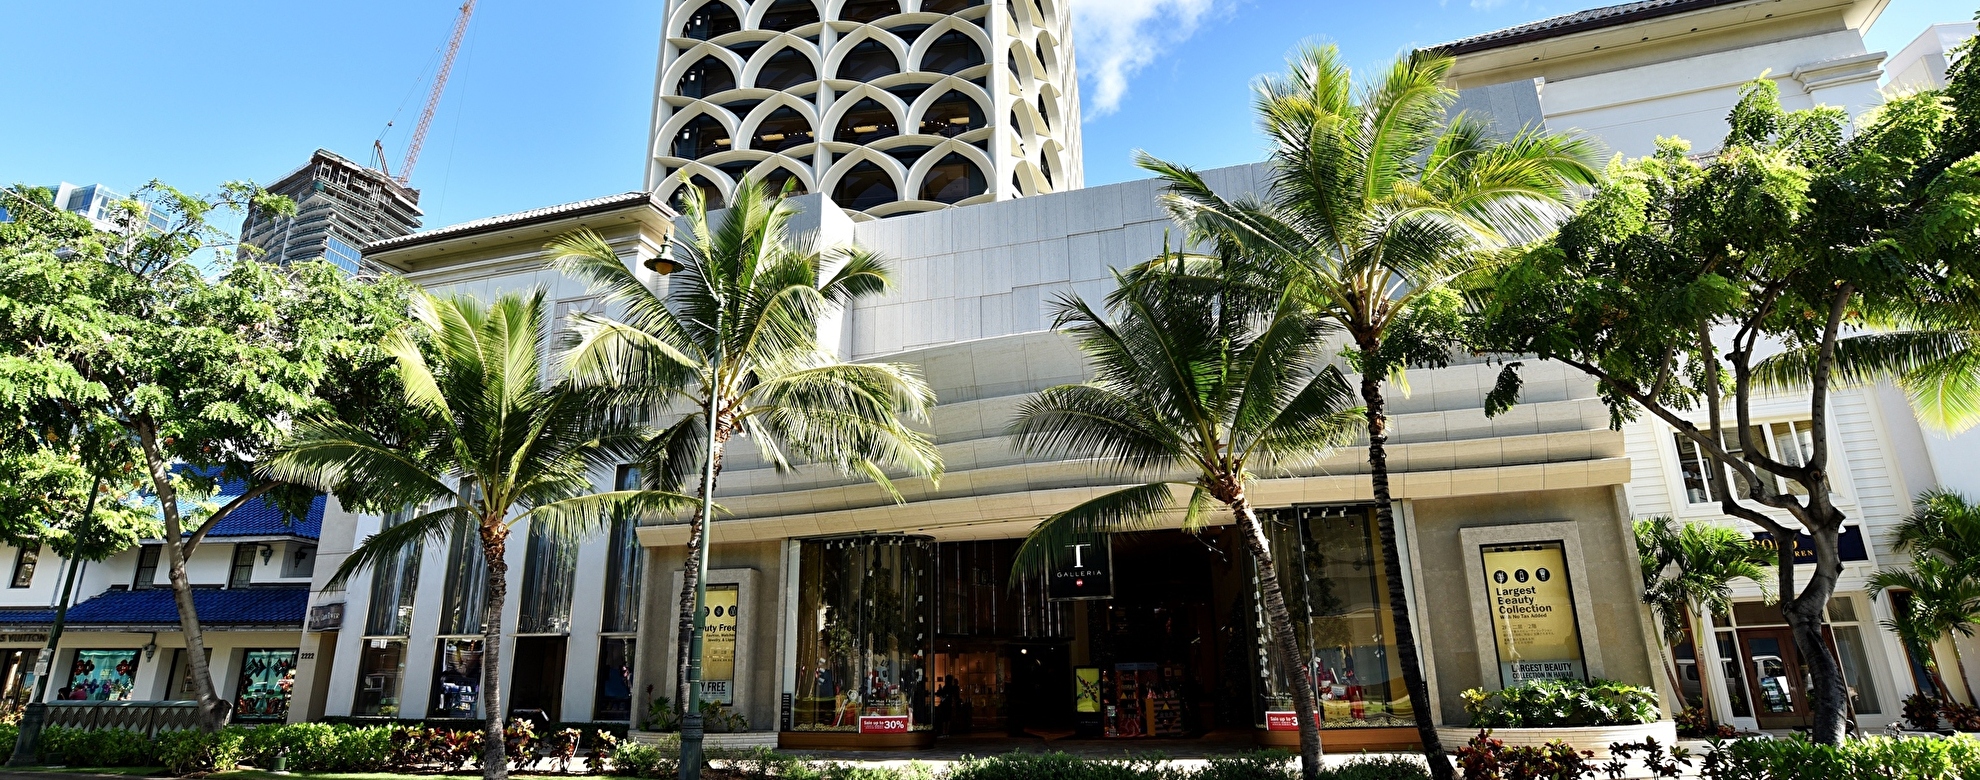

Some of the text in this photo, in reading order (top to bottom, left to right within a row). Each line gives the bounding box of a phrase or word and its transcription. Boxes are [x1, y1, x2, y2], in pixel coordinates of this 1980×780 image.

[1064, 544, 1091, 568] T
[1056, 570, 1102, 578] GALLERIA
[1496, 586, 1536, 597] Largest
[1497, 595, 1534, 605] Beauty
[1499, 604, 1552, 614] Collection
[704, 624, 717, 633] uty
[1544, 662, 1572, 671] BEAUTY
[707, 681, 726, 691] FREE
[884, 720, 904, 729] 30%
